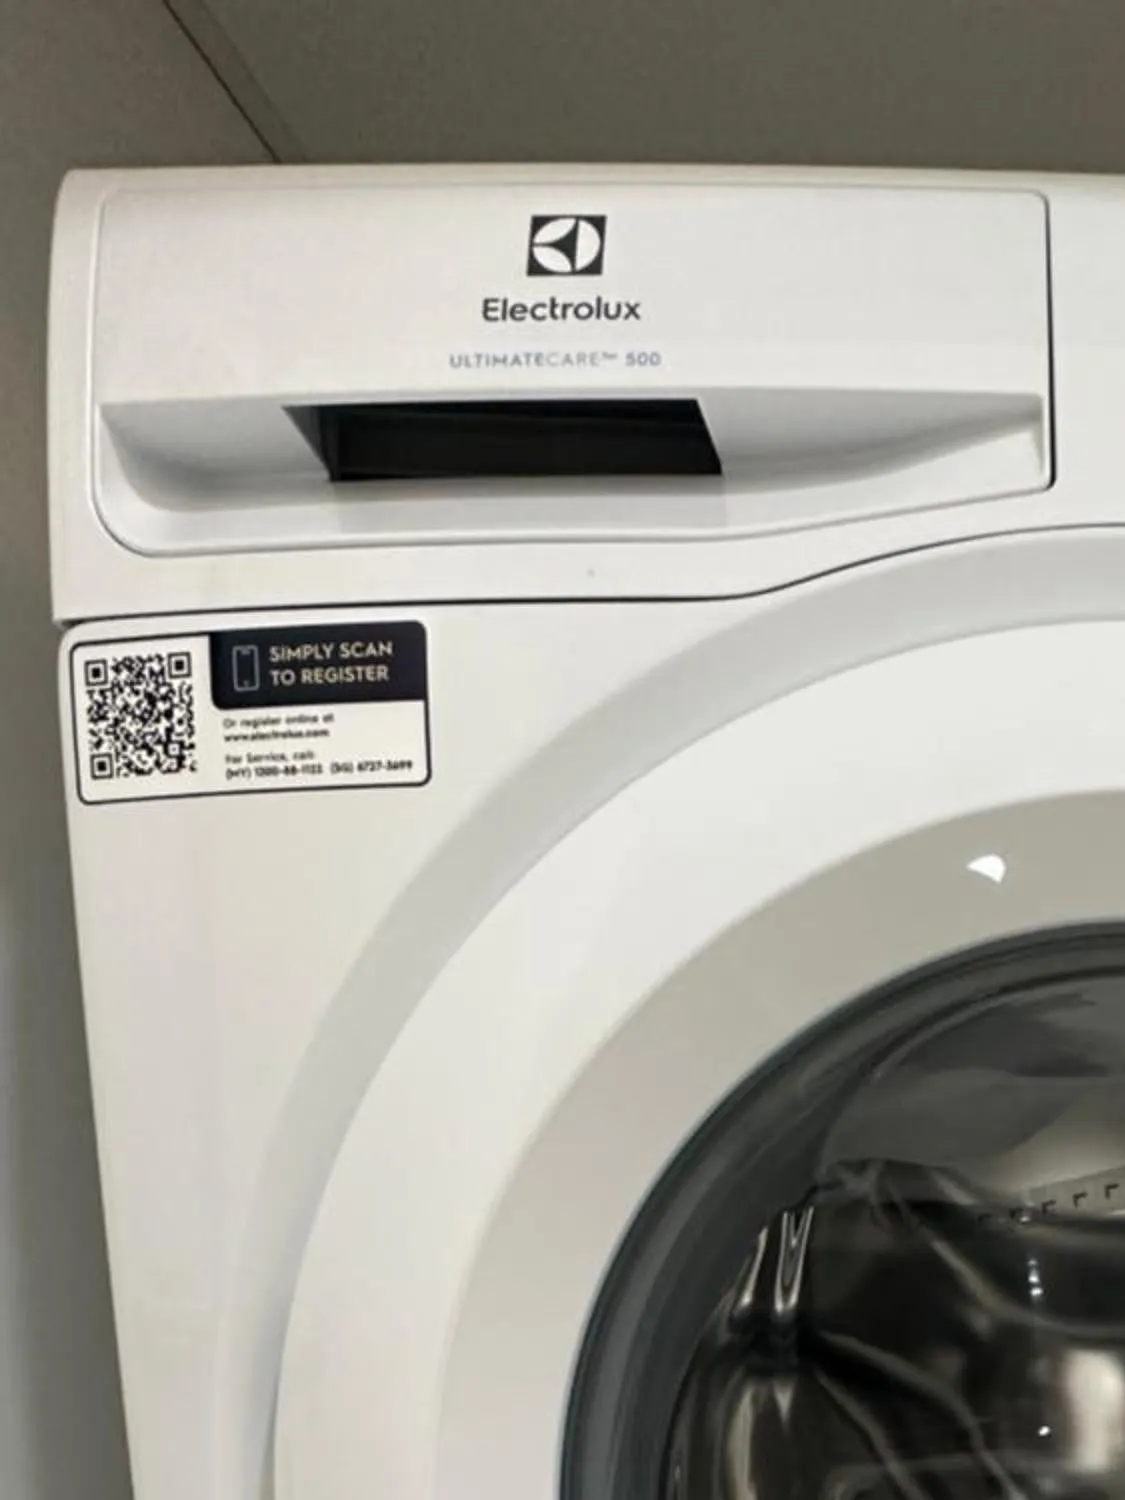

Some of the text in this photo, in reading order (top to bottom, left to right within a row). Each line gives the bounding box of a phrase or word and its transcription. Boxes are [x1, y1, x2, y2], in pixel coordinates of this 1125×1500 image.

[482, 295, 642, 323] Electrolux
[625, 351, 662, 368] 500
[268, 641, 393, 663] SIMPLY SCAN
[269, 665, 390, 686] TO REGISTER
